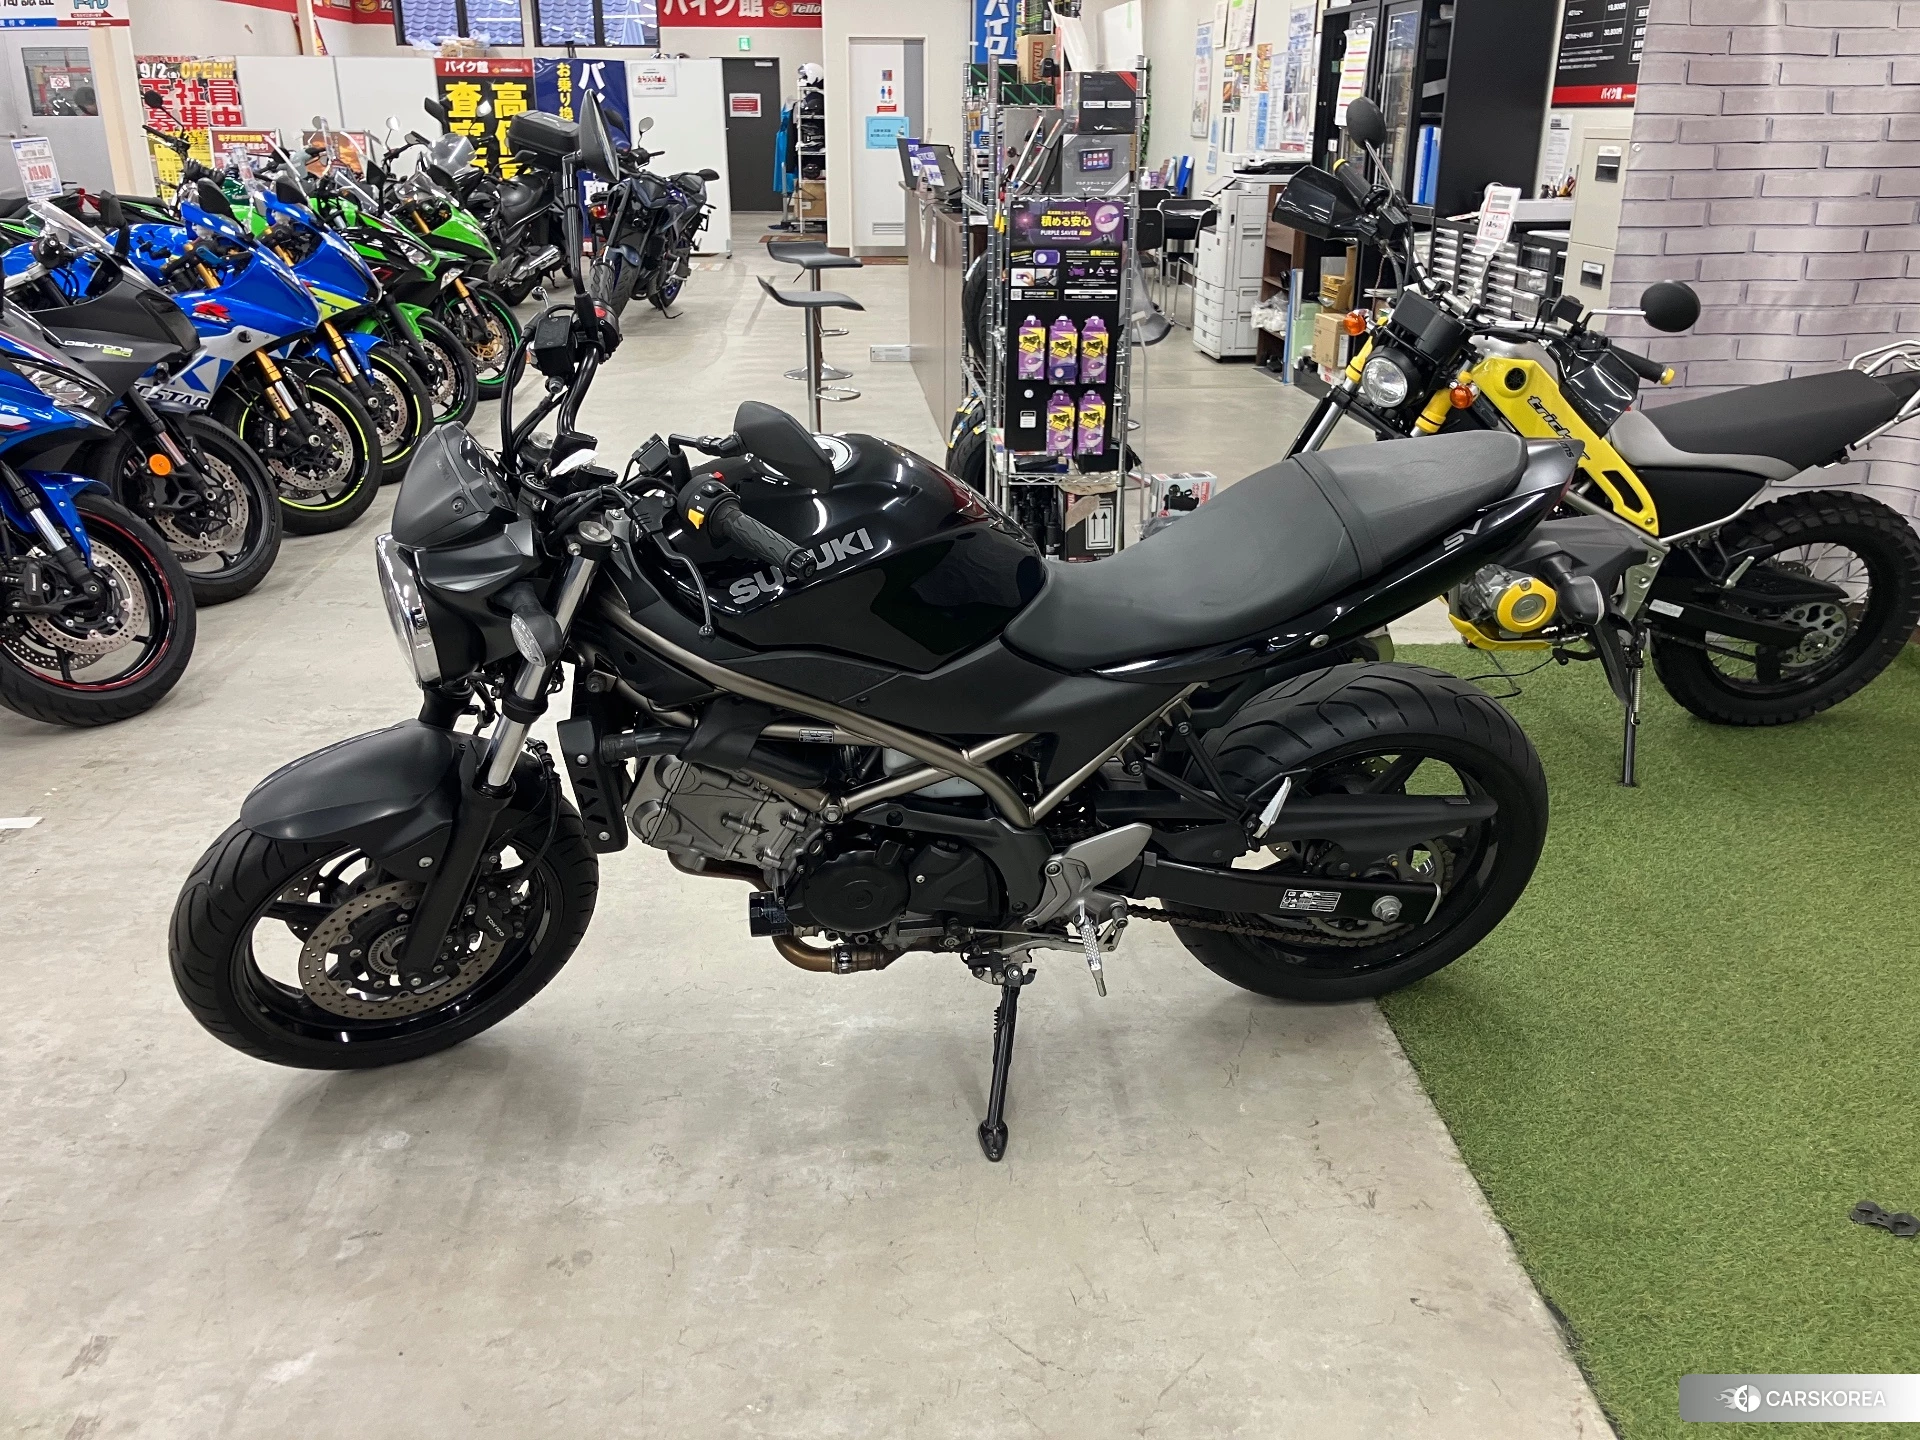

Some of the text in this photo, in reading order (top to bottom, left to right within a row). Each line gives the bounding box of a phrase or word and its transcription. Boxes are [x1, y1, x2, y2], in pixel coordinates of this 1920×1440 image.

[181, 62, 235, 79] OPEN!!
[444, 61, 489, 74] バイク館
[1041, 215, 1092, 227] 積める安心
[729, 527, 874, 604] SUUKI
